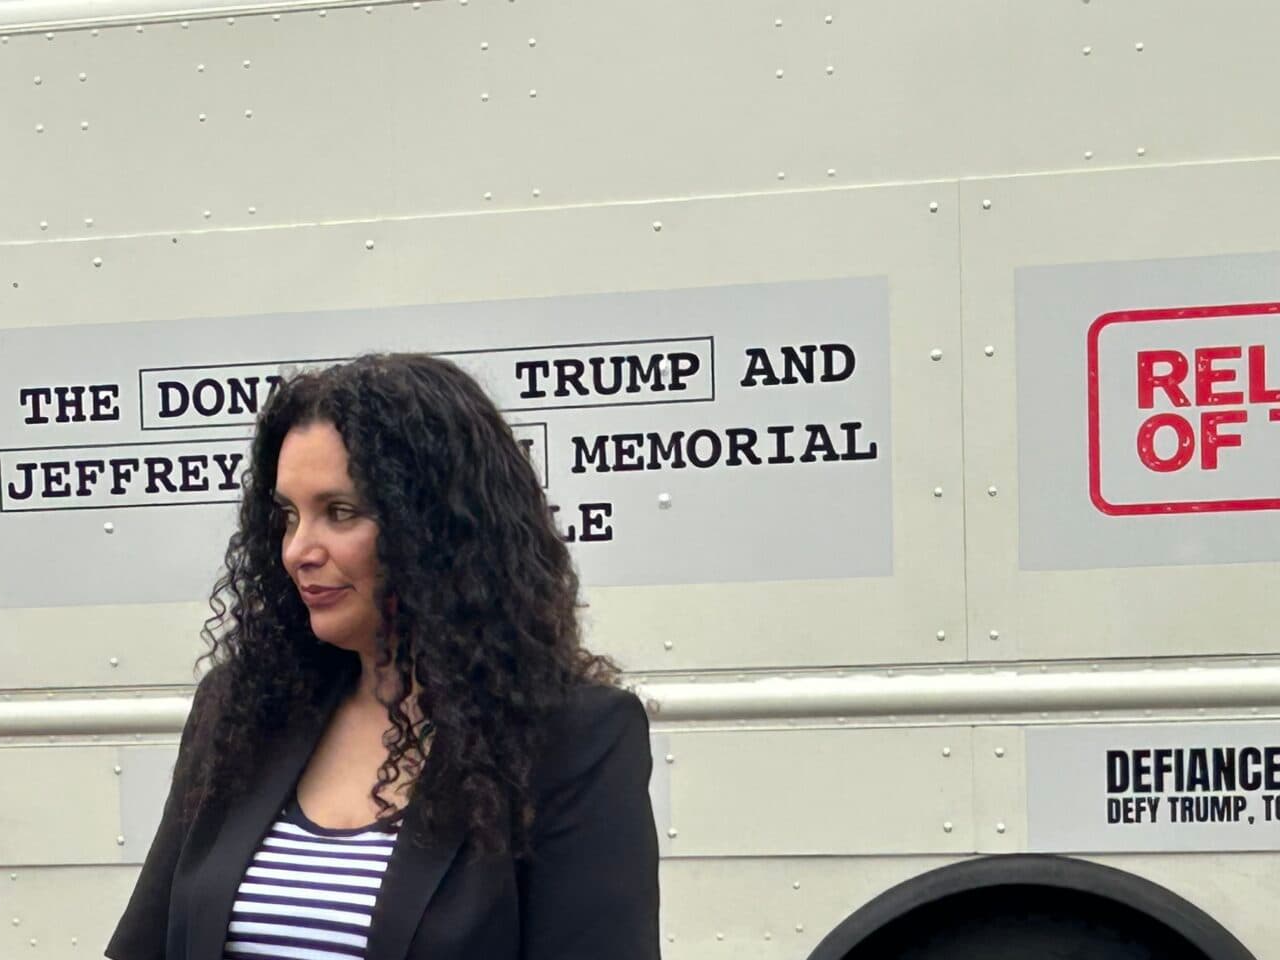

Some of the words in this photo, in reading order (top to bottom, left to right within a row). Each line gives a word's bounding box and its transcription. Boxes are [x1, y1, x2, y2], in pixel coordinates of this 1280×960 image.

[19, 384, 120, 424] THE
[515, 352, 700, 398] TRUMP
[740, 343, 856, 387] AND
[8, 453, 244, 500] JEFFREY
[571, 422, 878, 474] MEMORIAL
[1137, 410, 1248, 472] OF
[1106, 747, 1280, 793] DEFIANCE
[1107, 797, 1160, 824] DEFY
[1167, 795, 1255, 825] TRUMP,
[1262, 795, 1280, 821] T
